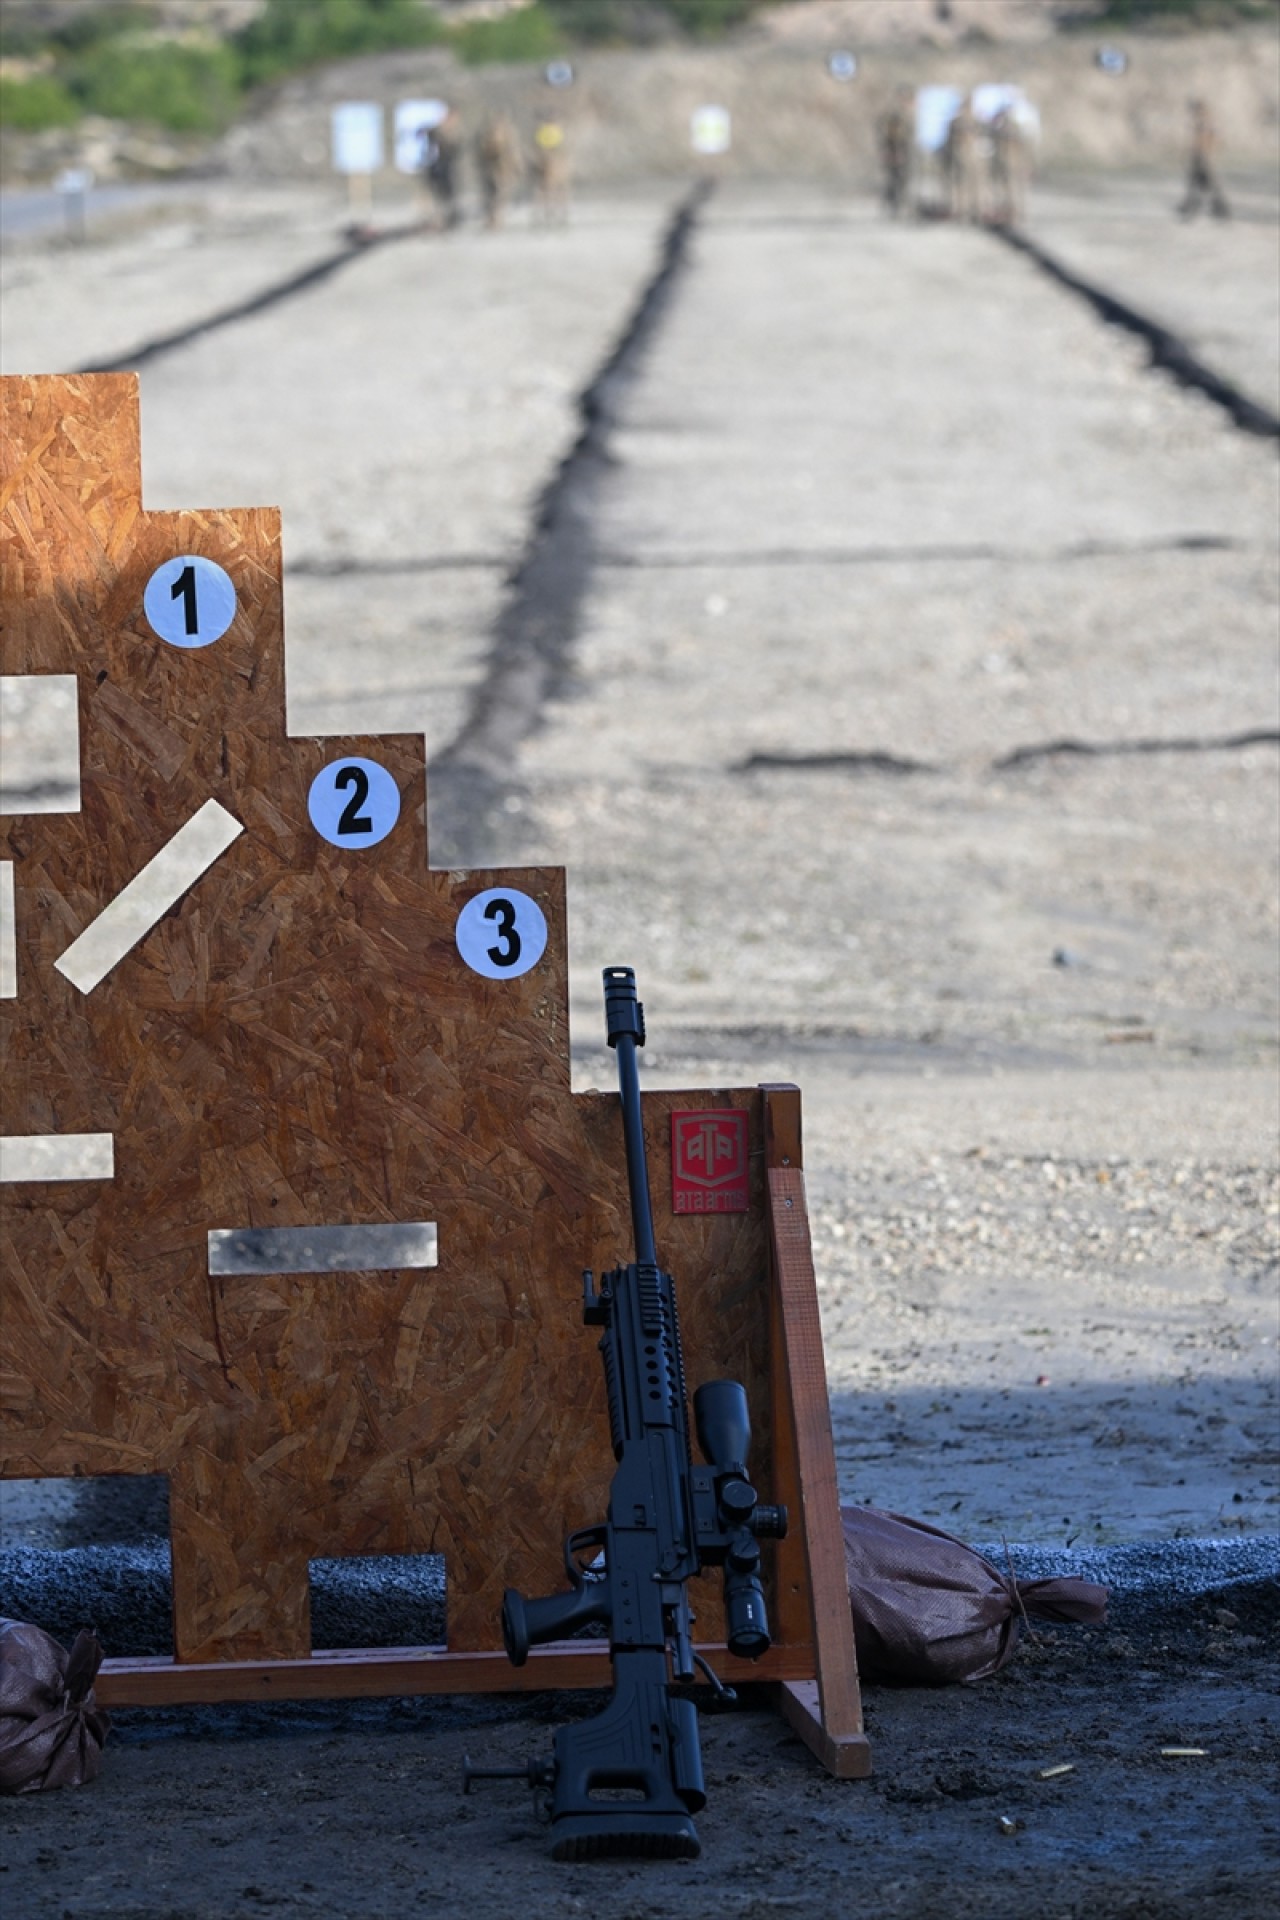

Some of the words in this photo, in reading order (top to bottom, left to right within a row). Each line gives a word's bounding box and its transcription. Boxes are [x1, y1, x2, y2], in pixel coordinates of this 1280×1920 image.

[170, 565, 199, 636] 1
[334, 765, 373, 836] 2
[483, 897, 522, 967] 3
